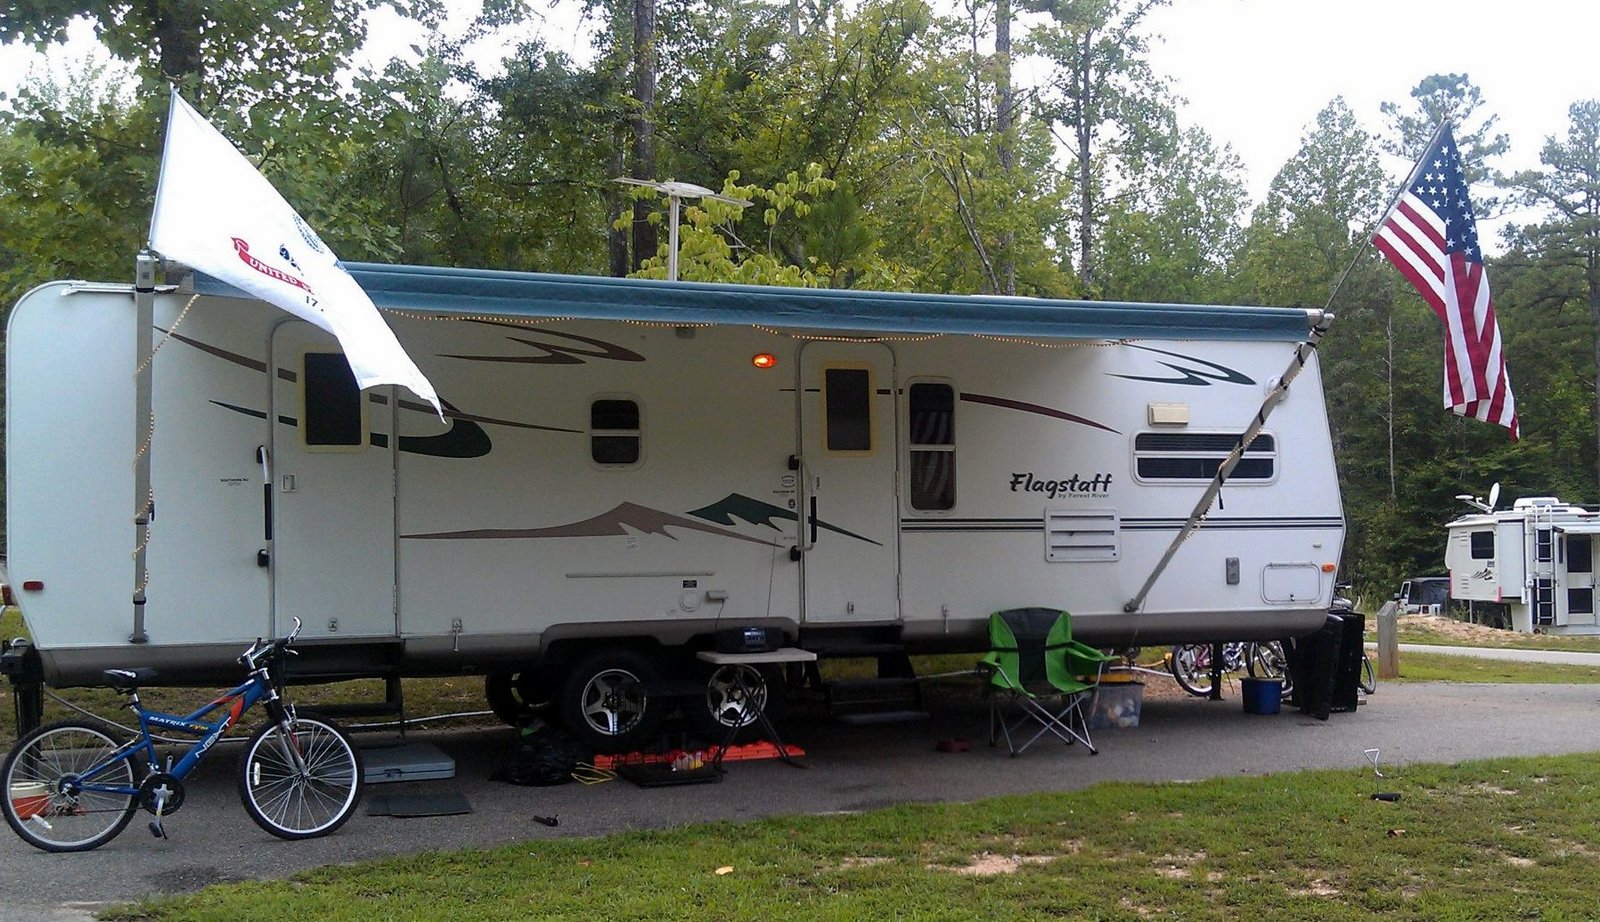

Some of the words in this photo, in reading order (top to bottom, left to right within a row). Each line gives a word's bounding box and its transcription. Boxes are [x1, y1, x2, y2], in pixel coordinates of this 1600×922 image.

[250, 259, 298, 284] UNITED
[1009, 472, 1113, 499] Flagstaff
[148, 716, 187, 727] MATRIX
[194, 716, 232, 758] NEXT
